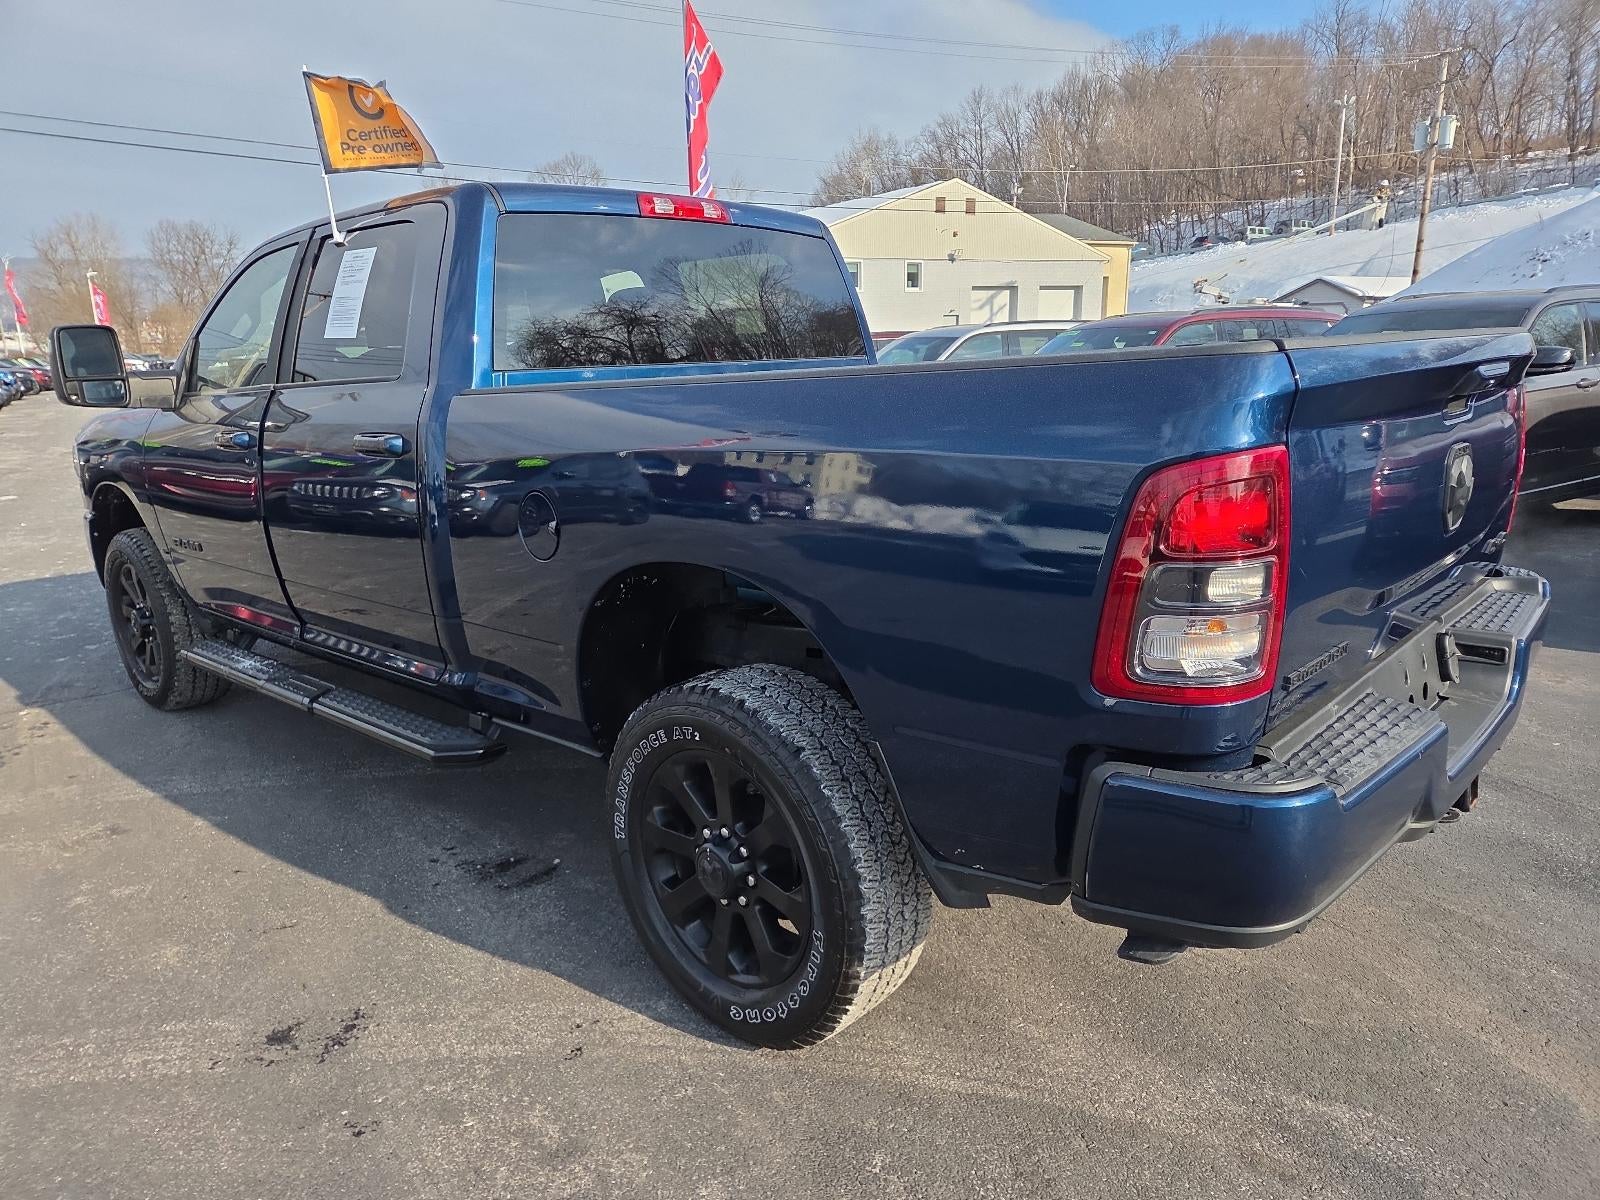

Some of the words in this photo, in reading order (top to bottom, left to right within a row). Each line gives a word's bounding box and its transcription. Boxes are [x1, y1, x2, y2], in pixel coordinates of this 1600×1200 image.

[347, 126, 408, 142] Certified
[614, 729, 668, 840] TRANSFORCE
[729, 929, 824, 1023] Firestone
